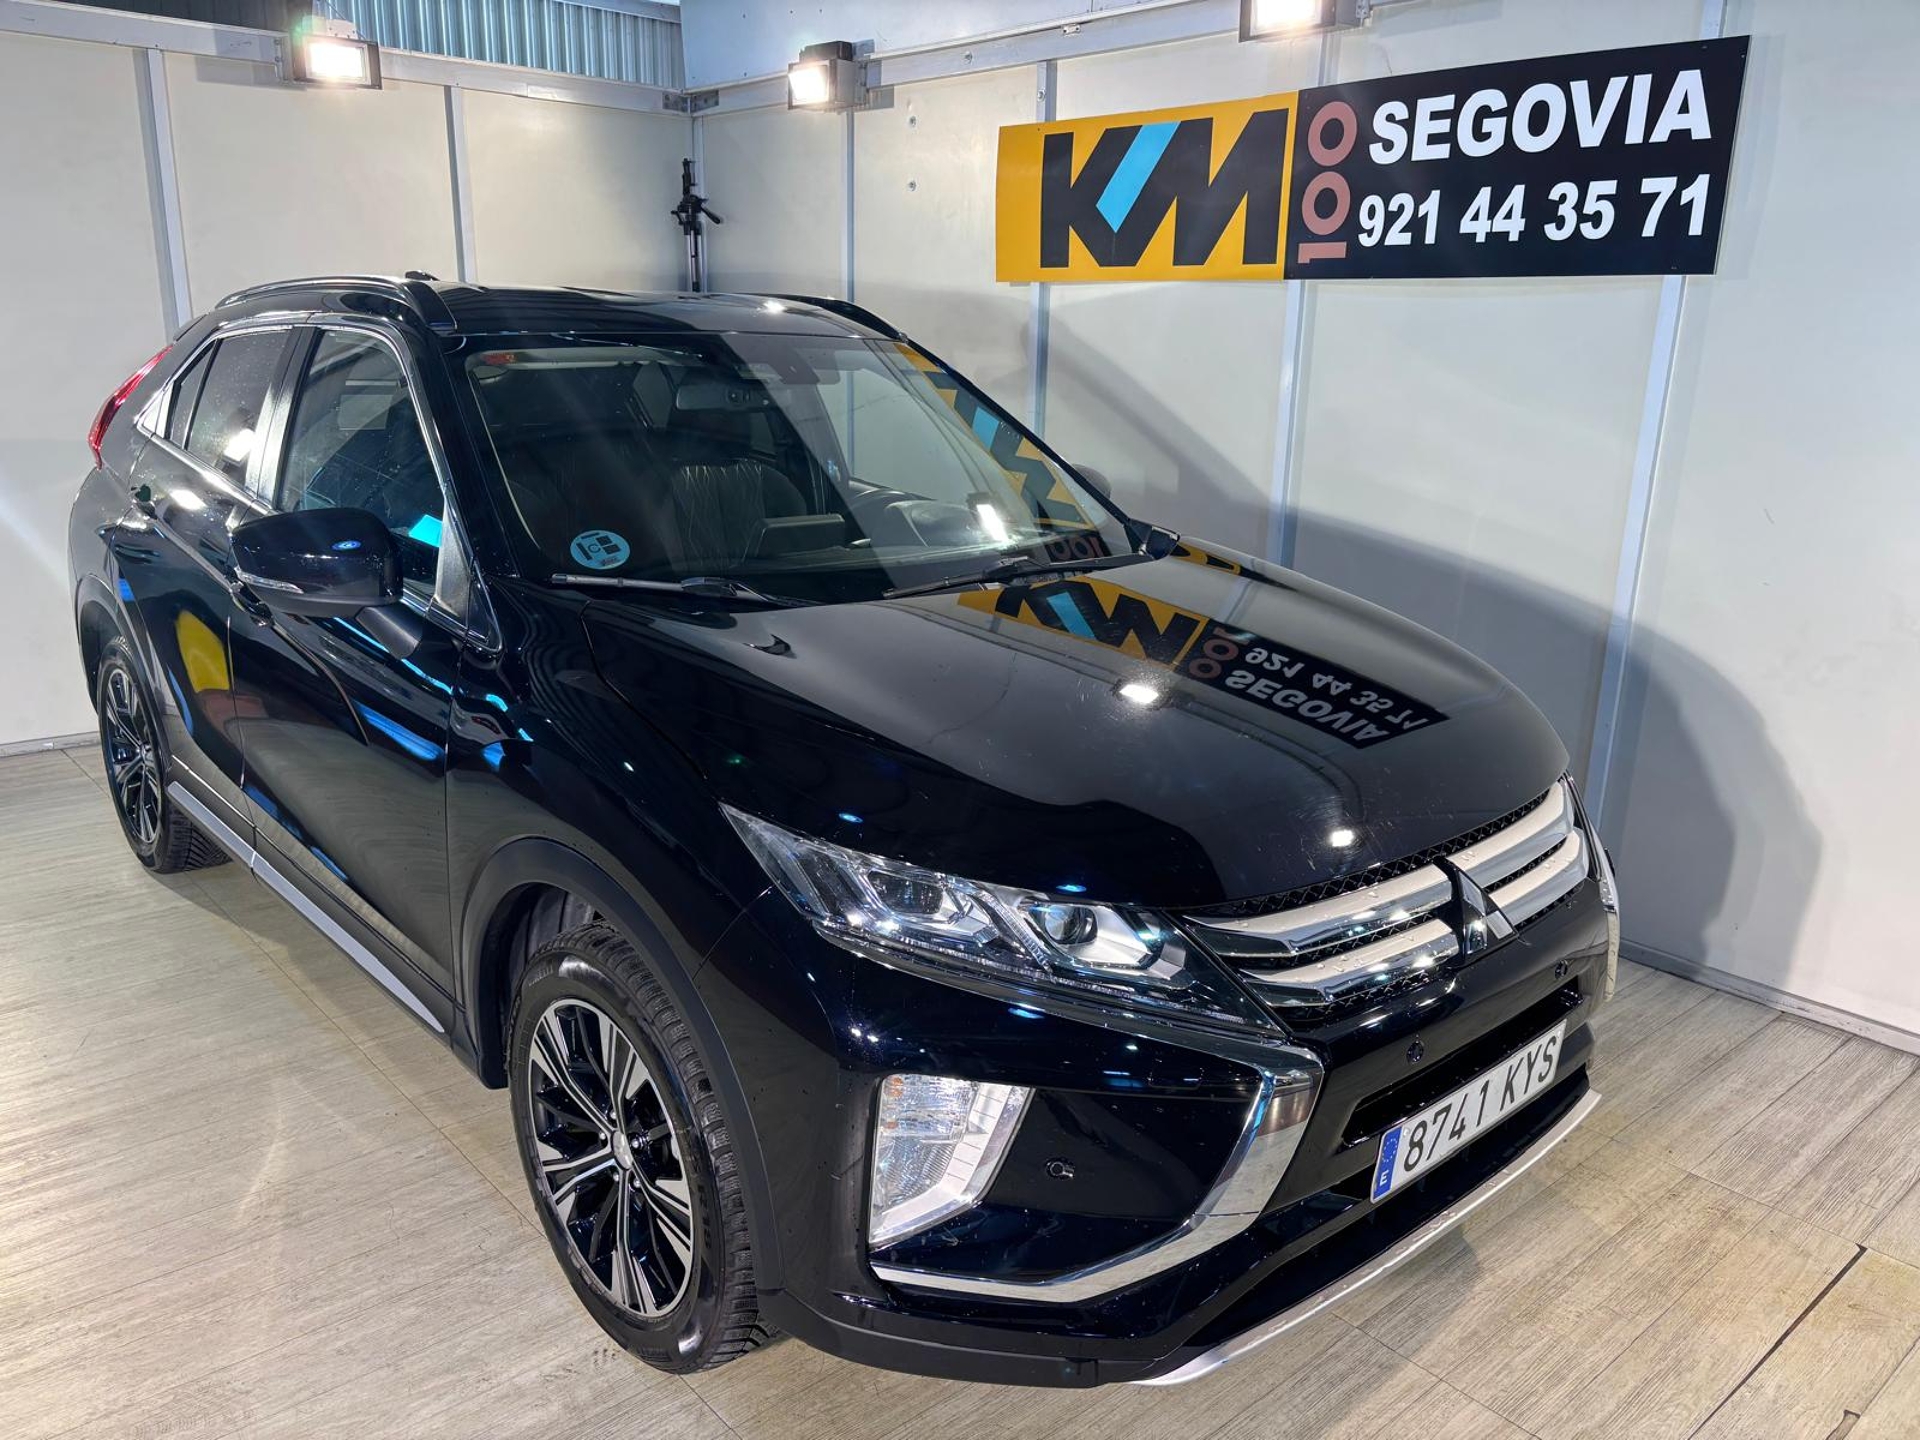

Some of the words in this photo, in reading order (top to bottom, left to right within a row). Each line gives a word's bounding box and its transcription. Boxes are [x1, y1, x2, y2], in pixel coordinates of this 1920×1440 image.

[1369, 69, 1712, 165] SEGOVIA
[1041, 109, 1288, 268] KM
[1298, 101, 1357, 264] 100
[1358, 190, 1440, 247] 921
[1460, 182, 1526, 243] 44
[1544, 179, 1618, 241] 35
[1640, 173, 1711, 237] 71
[1403, 1080, 1489, 1172] 8741
[1500, 1035, 1556, 1112] KYS
[1380, 1171, 1388, 1186] E
